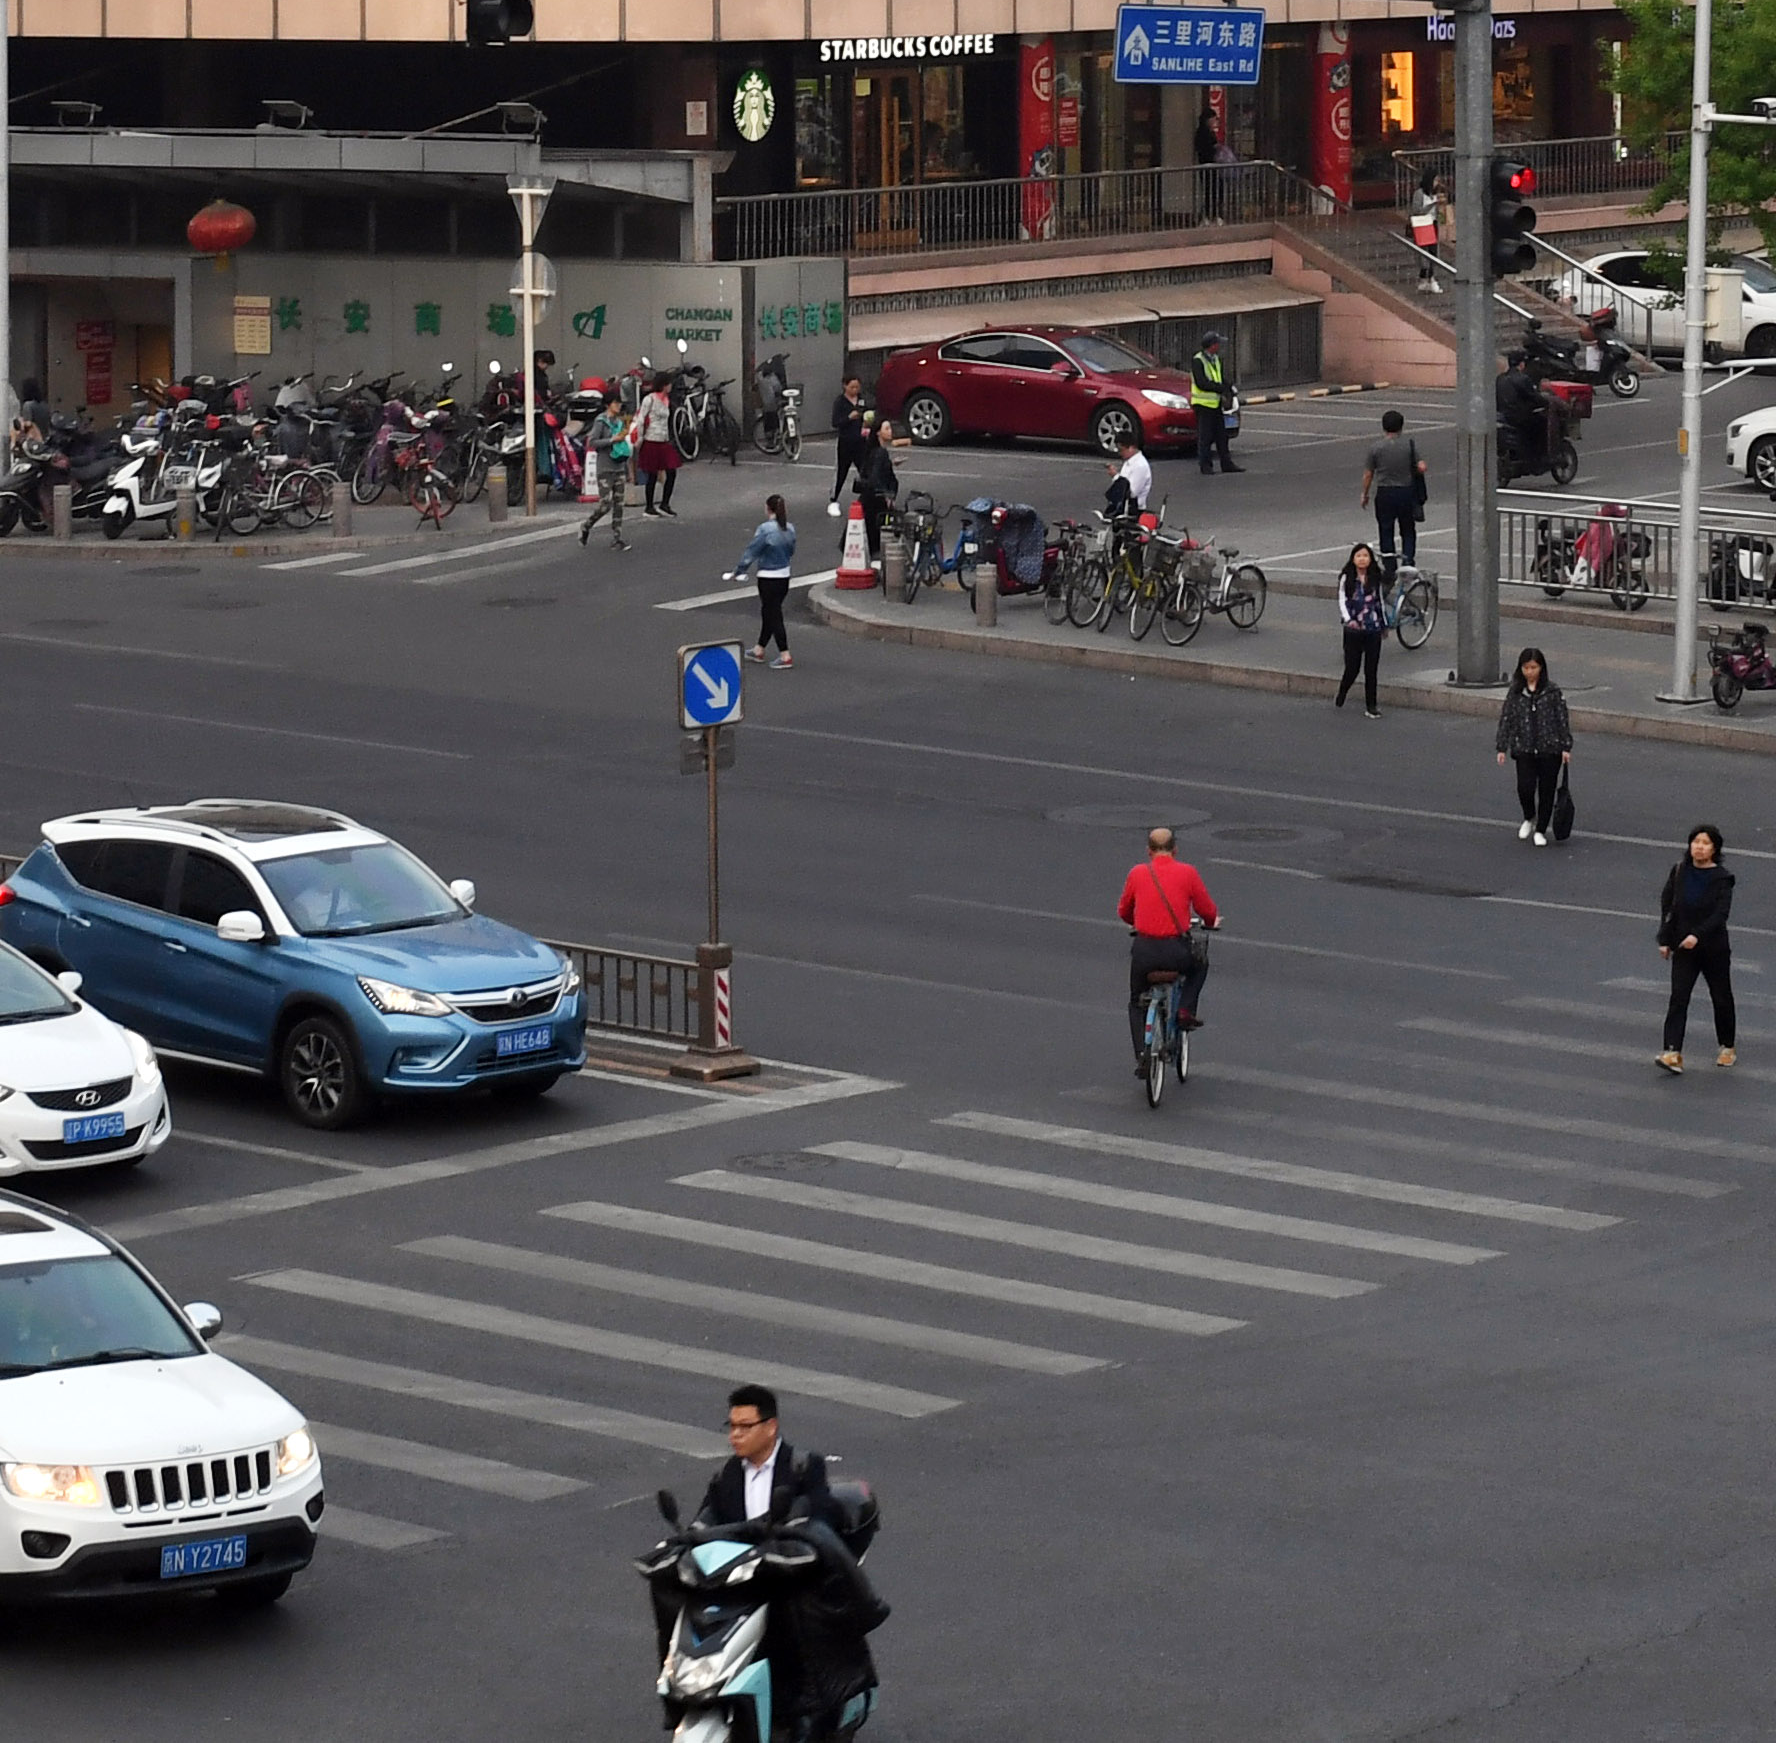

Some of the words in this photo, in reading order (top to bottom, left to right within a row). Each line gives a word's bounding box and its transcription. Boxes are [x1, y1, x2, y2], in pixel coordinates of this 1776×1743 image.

[819, 35, 926, 63] STARBUCKS
[928, 33, 996, 57] COFFEE
[1153, 19, 1257, 48] 三里河东路
[1151, 57, 1203, 72] SANLIHE
[1208, 58, 1234, 72] East
[1239, 59, 1254, 73] Rd
[276, 296, 517, 337] 长安商场
[665, 307, 733, 323] CHANGAN
[759, 300, 842, 340] 长安商场
[665, 328, 723, 342] MARKET
